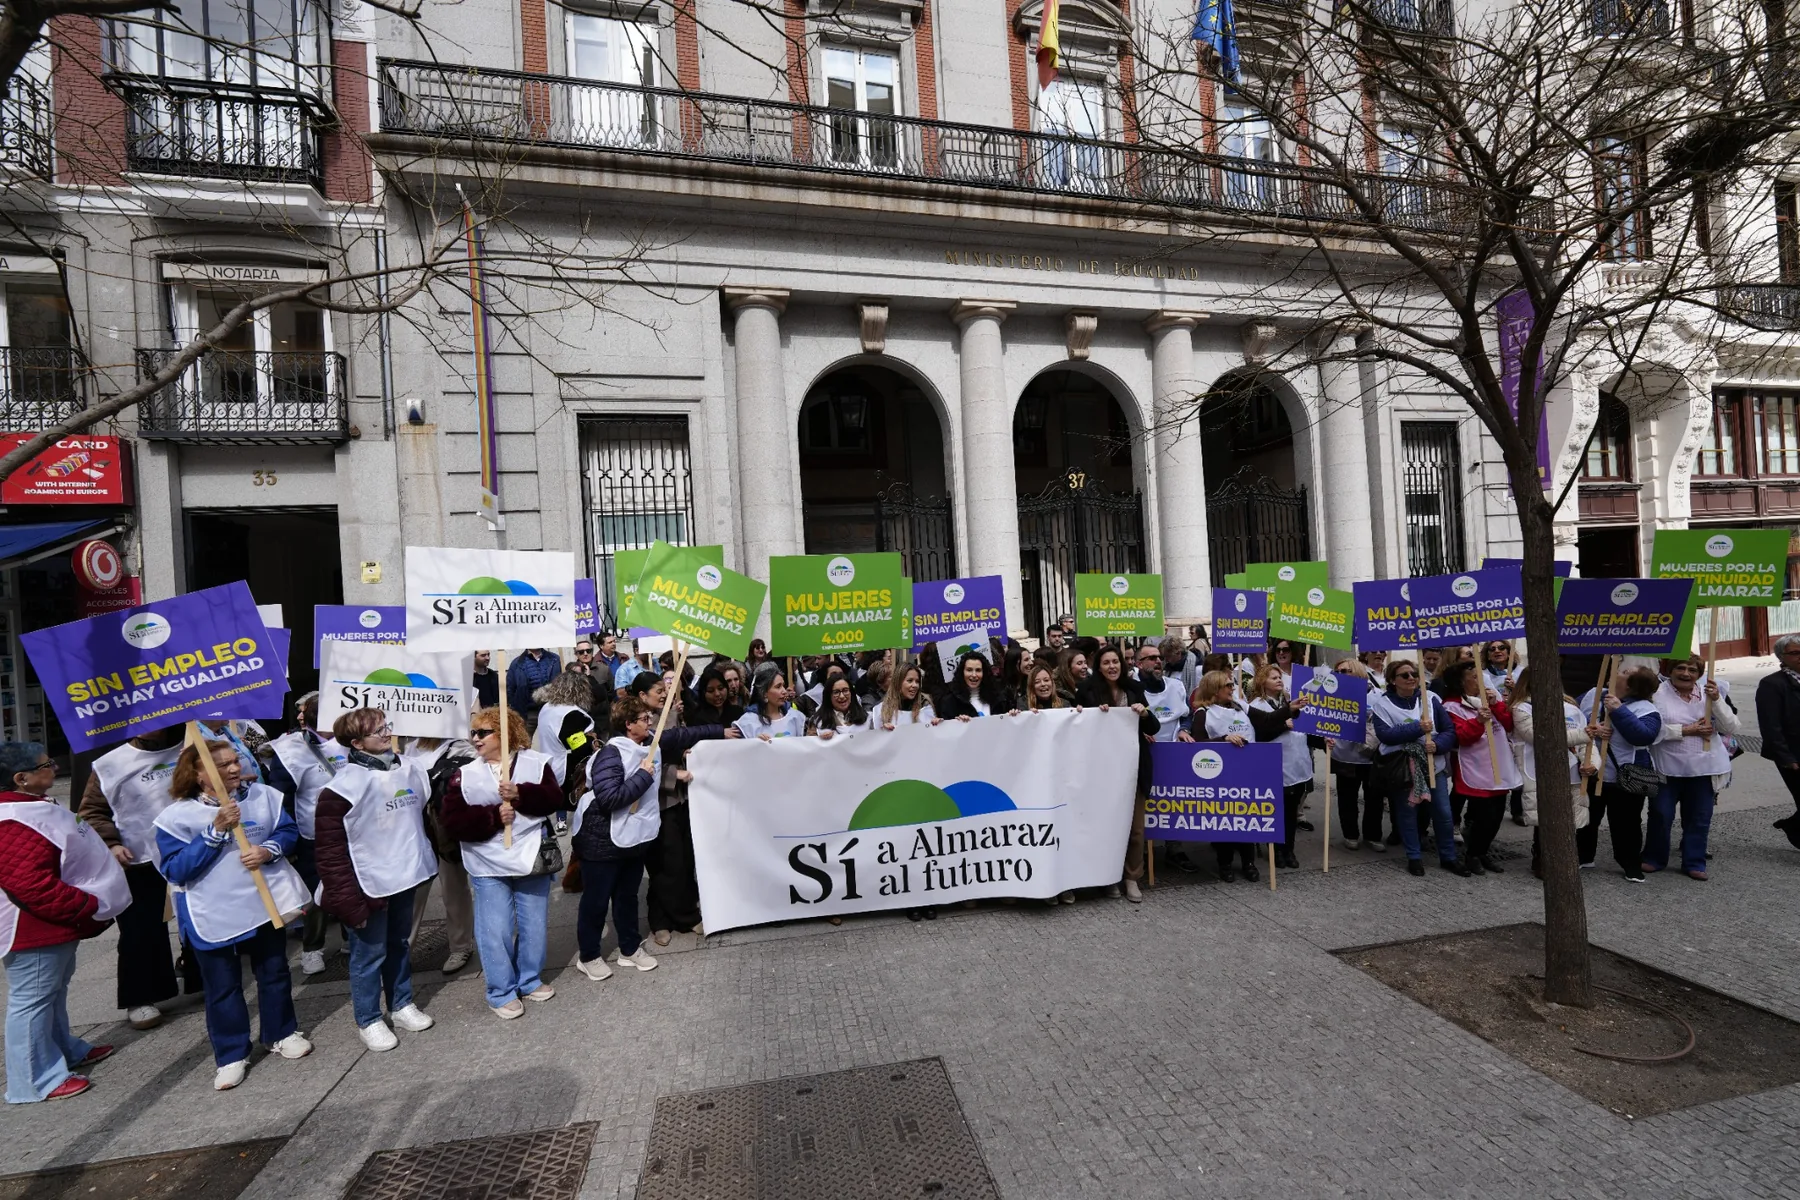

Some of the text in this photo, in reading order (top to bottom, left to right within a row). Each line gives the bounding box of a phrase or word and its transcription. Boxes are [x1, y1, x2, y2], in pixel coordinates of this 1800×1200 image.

[944, 250, 1199, 281] MINISTERIO DE IGUALDAD
[212, 267, 280, 281] NOTARIA
[55, 440, 109, 449] CARD
[253, 469, 278, 487] 35
[1069, 473, 1086, 489] 37
[1660, 563, 1776, 572] MUJERES POR LA
[1698, 585, 1774, 597] LMARAZ
[86, 599, 137, 607] ACCESORIOS
[652, 575, 748, 624] MUJERES
[785, 589, 892, 612] MUJERES
[1085, 597, 1156, 610] MUJERES
[1414, 603, 1474, 617] MUJERES
[1477, 598, 1503, 610] POR
[1505, 596, 1523, 606] LA
[432, 598, 562, 625] Sí a Almaraz,
[475, 611, 547, 625] al futuro
[647, 591, 678, 612] POR
[678, 604, 743, 636] ALMARAZ
[786, 613, 819, 627] POR
[822, 608, 893, 625] ALMARAZ
[914, 608, 1000, 626] SIN EMPLEO
[1085, 610, 1156, 618] POR ALMARAZ
[1281, 602, 1346, 625] MUJERES
[1416, 606, 1524, 628] CONTINUIDAD
[1563, 613, 1673, 626] SIN EMPLEO
[672, 619, 711, 640] 4.000
[915, 627, 930, 636] NO
[931, 625, 951, 634] HAY
[1107, 622, 1135, 631] 4.000
[1216, 618, 1264, 630] SIN EMPLEO
[1280, 614, 1345, 634] POR ALMARAZ
[1368, 621, 1396, 631] POR
[1418, 617, 1525, 640] DE ALMARAZ
[1560, 627, 1670, 636] NO HAY IGUALDAD
[322, 632, 375, 640] MUJERES
[377, 632, 399, 640] POR
[821, 629, 864, 644] 4.000
[1237, 630, 1264, 638] IGUALDAD
[1298, 628, 1324, 640] 4.000
[66, 637, 257, 702] SIN EMPLEO
[74, 656, 265, 719] NO HAY IGUALDAD
[340, 685, 458, 709] Sí a Almaraz,
[85, 679, 273, 737] MUJERES DE ALMARAZ POR LA CONTINUIDAD
[376, 700, 443, 715] al futuro
[1317, 708, 1359, 724] ALMARAZ
[1316, 721, 1341, 733] 4.000
[1218, 787, 1251, 799] POR
[1254, 787, 1275, 800] LA
[1144, 799, 1275, 816] CONTINUIDAD
[1144, 814, 1275, 832] DE ALMARAZ
[787, 822, 1061, 905] Sí a Almaraz,
[878, 856, 1033, 896] al futuro
